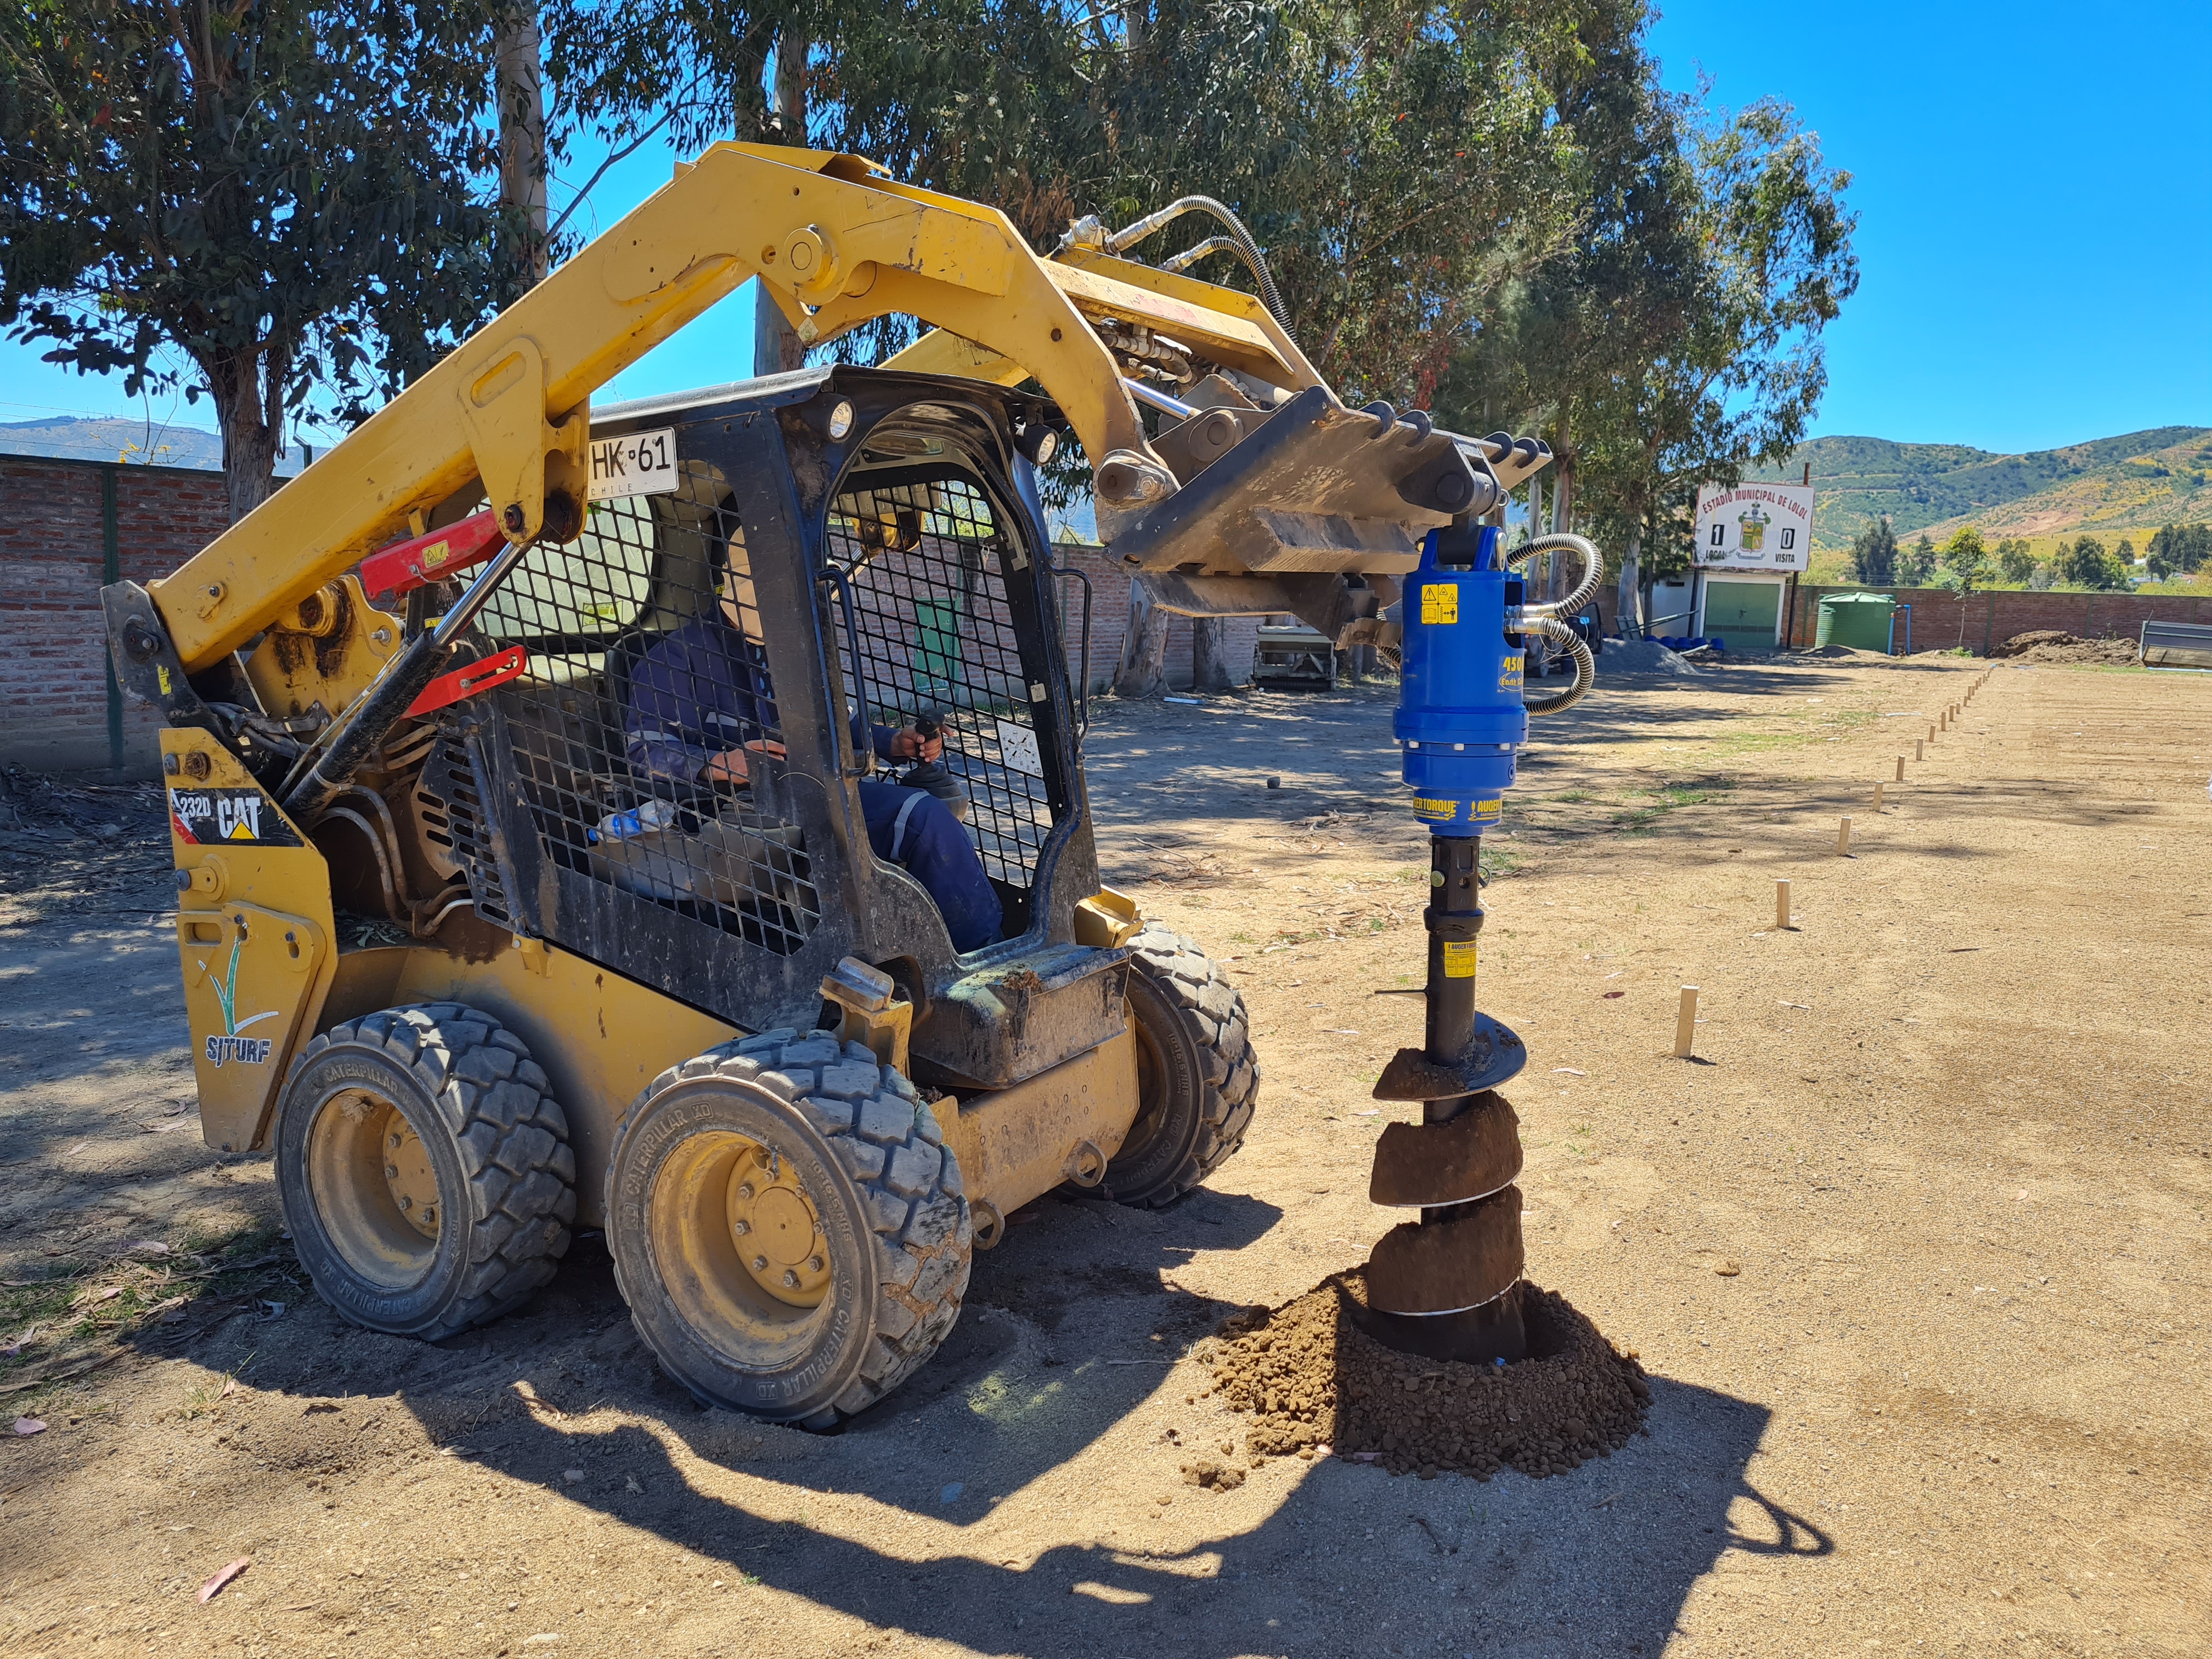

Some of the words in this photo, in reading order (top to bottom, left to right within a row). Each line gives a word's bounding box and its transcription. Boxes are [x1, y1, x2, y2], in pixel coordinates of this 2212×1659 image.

[639, 436, 670, 472] 61
[591, 483, 633, 496] CHILE
[1702, 492, 1733, 514] ESTADIO
[1735, 489, 1775, 504] MUNICIPAL
[1778, 495, 1787, 507] DE
[1787, 499, 1808, 520] LOLOL
[1714, 525, 1720, 544] 1
[1782, 529, 1792, 548] 0
[1706, 550, 1725, 560] LOCAL
[1775, 554, 1795, 563] VISITA
[180, 797, 211, 817] 232D
[217, 797, 261, 839] CAT
[324, 1063, 398, 1093] CATERPILLAR
[1181, 1074, 1189, 1096] NHS
[627, 1108, 688, 1196] CATERPILLAR
[692, 1104, 712, 1118] XD
[811, 1159, 842, 1209] 10-16.5
[837, 1211, 852, 1241] NHS
[337, 1279, 410, 1315] CATERPILLAR
[842, 1277, 853, 1301] XD
[781, 1309, 850, 1397] CATERPILLAR
